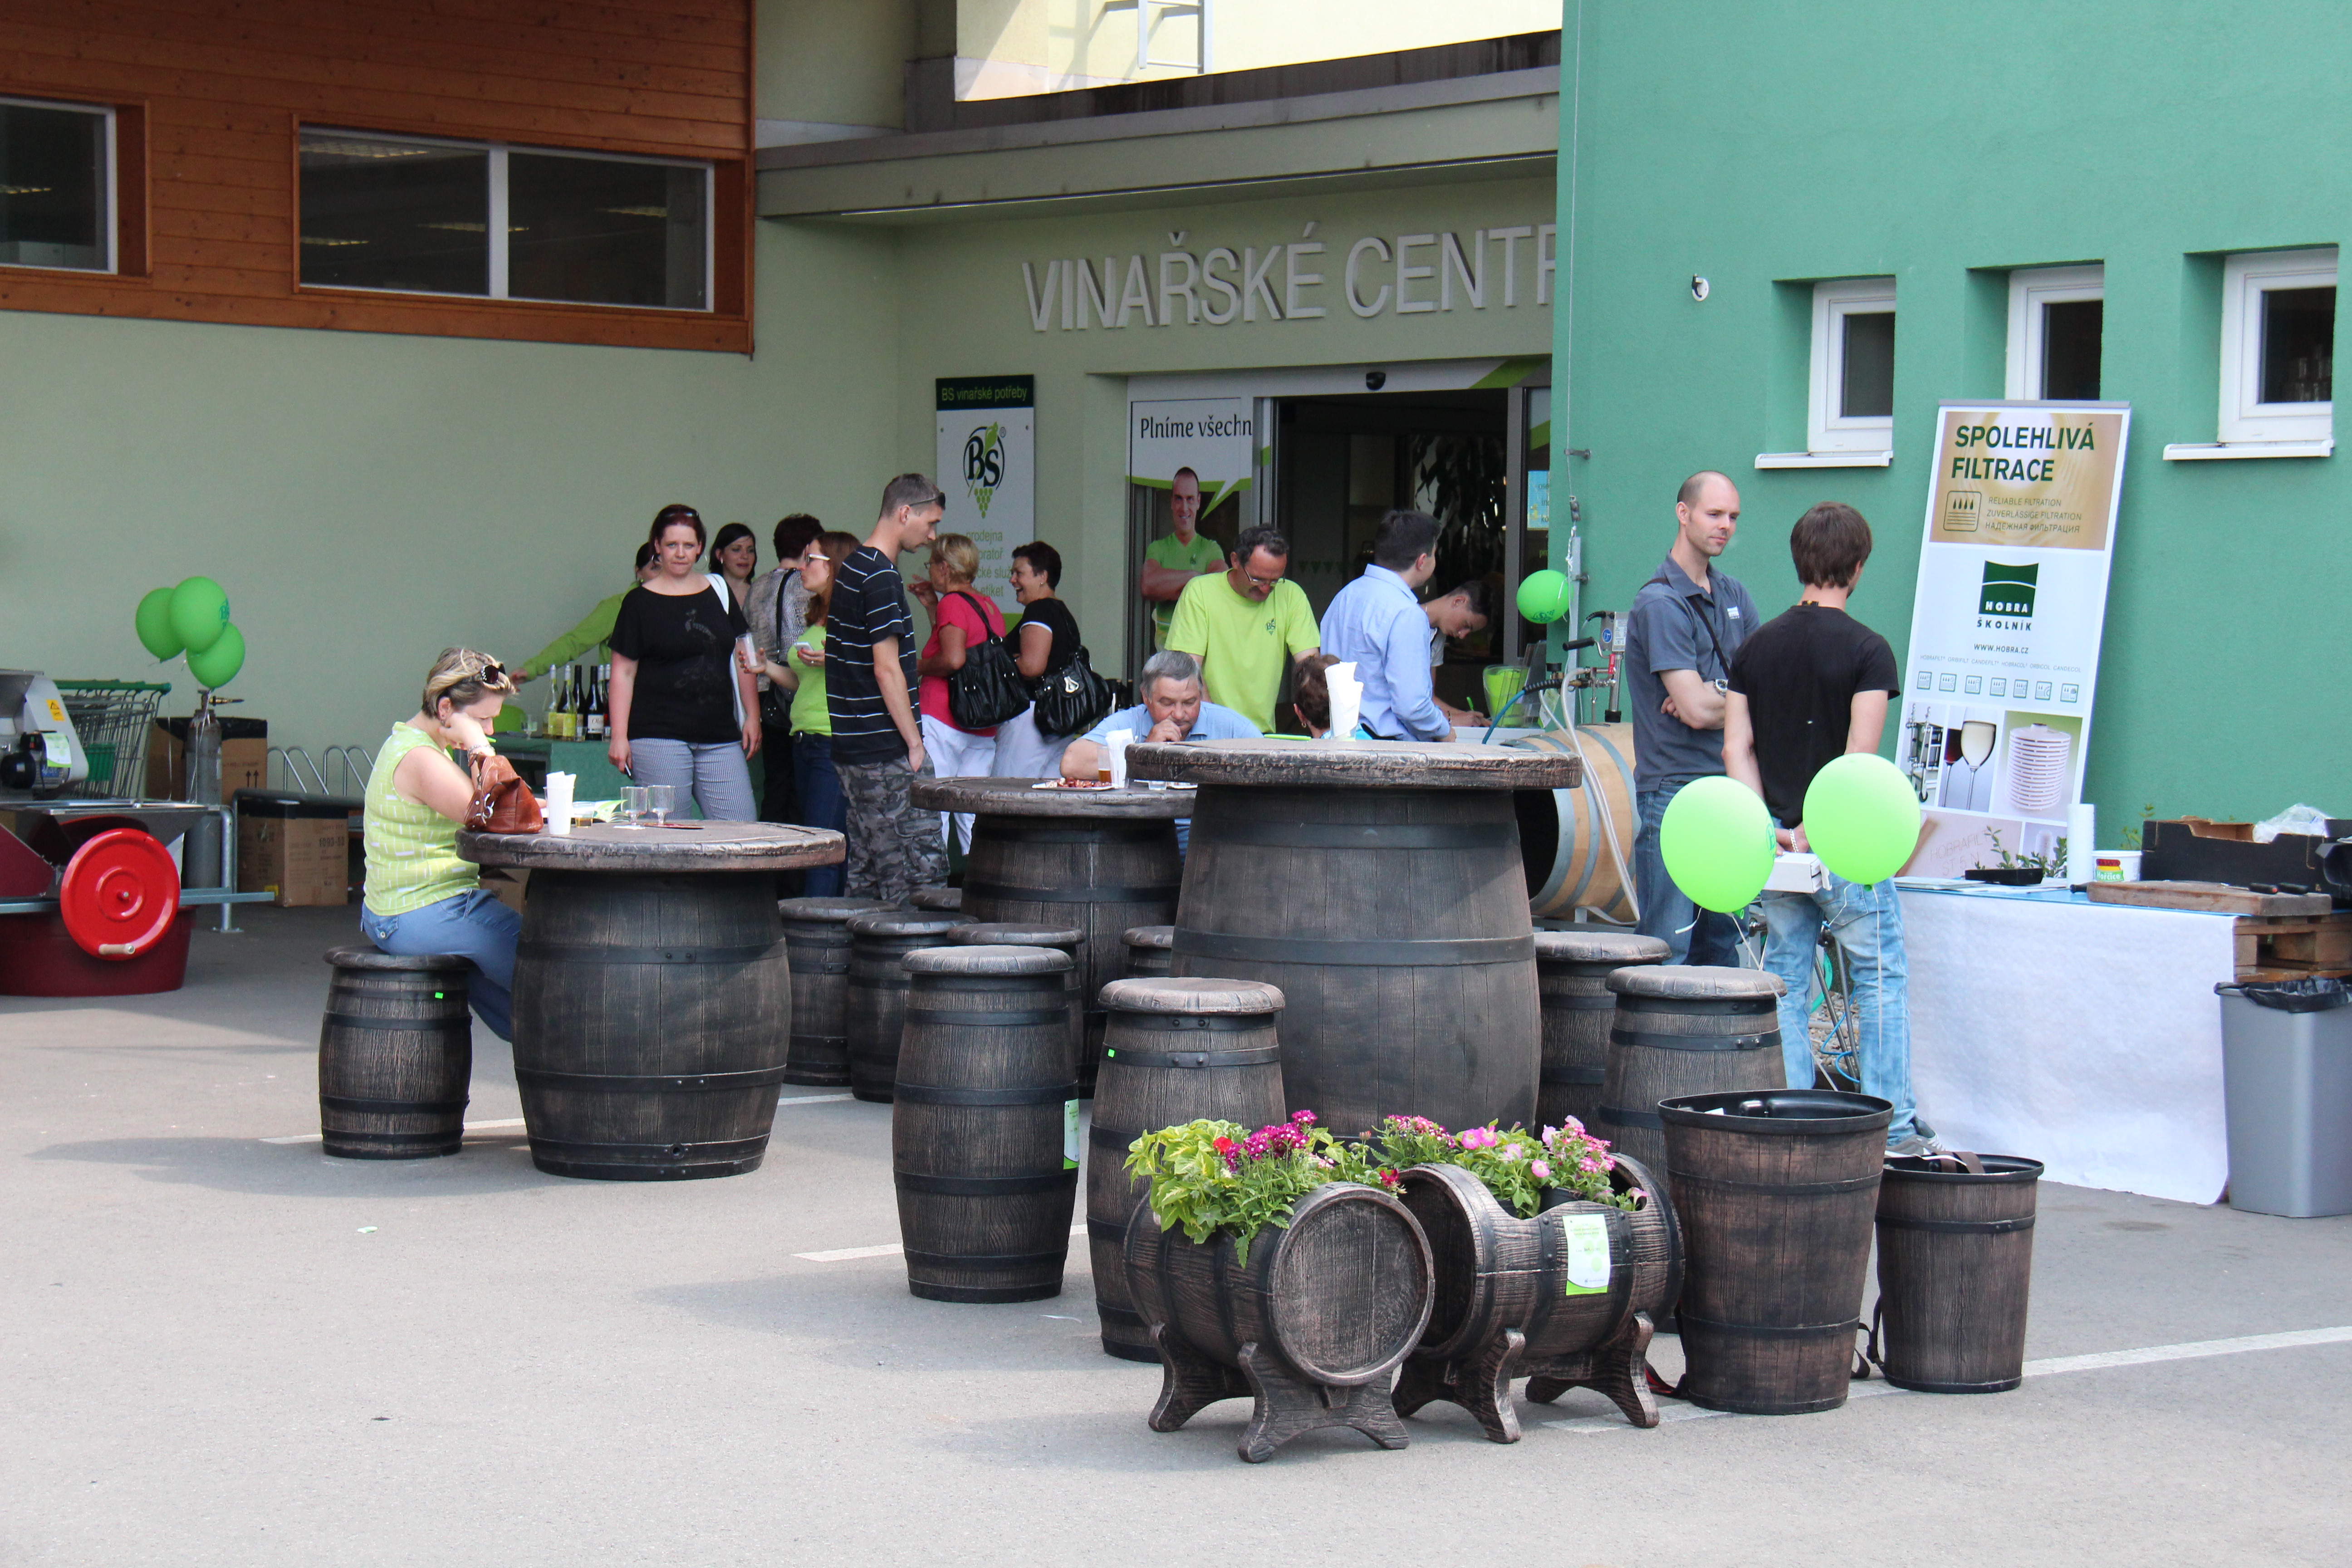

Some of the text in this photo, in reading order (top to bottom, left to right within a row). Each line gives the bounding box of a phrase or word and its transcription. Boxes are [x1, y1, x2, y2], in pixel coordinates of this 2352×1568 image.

[1022, 220, 1327, 332] VINAŘSKÉ
[941, 385, 1028, 402] BS vinařské potřeby
[1141, 416, 1194, 439] Plníme
[1955, 422, 2095, 450] SPOLEHLIVÁ
[1951, 457, 2055, 482] FILTRACE
[1988, 496, 2062, 507] RELIABLE FILTRATION
[1986, 509, 2082, 521] ZUVERLÄSSIGE FILTRATION
[1984, 600, 2029, 613] HOBRA
[1976, 616, 2032, 632] ŠKOLNÍK
[1973, 643, 2029, 654] WWW.HOBRA.CZ
[2096, 871, 2121, 881] Hořčice
